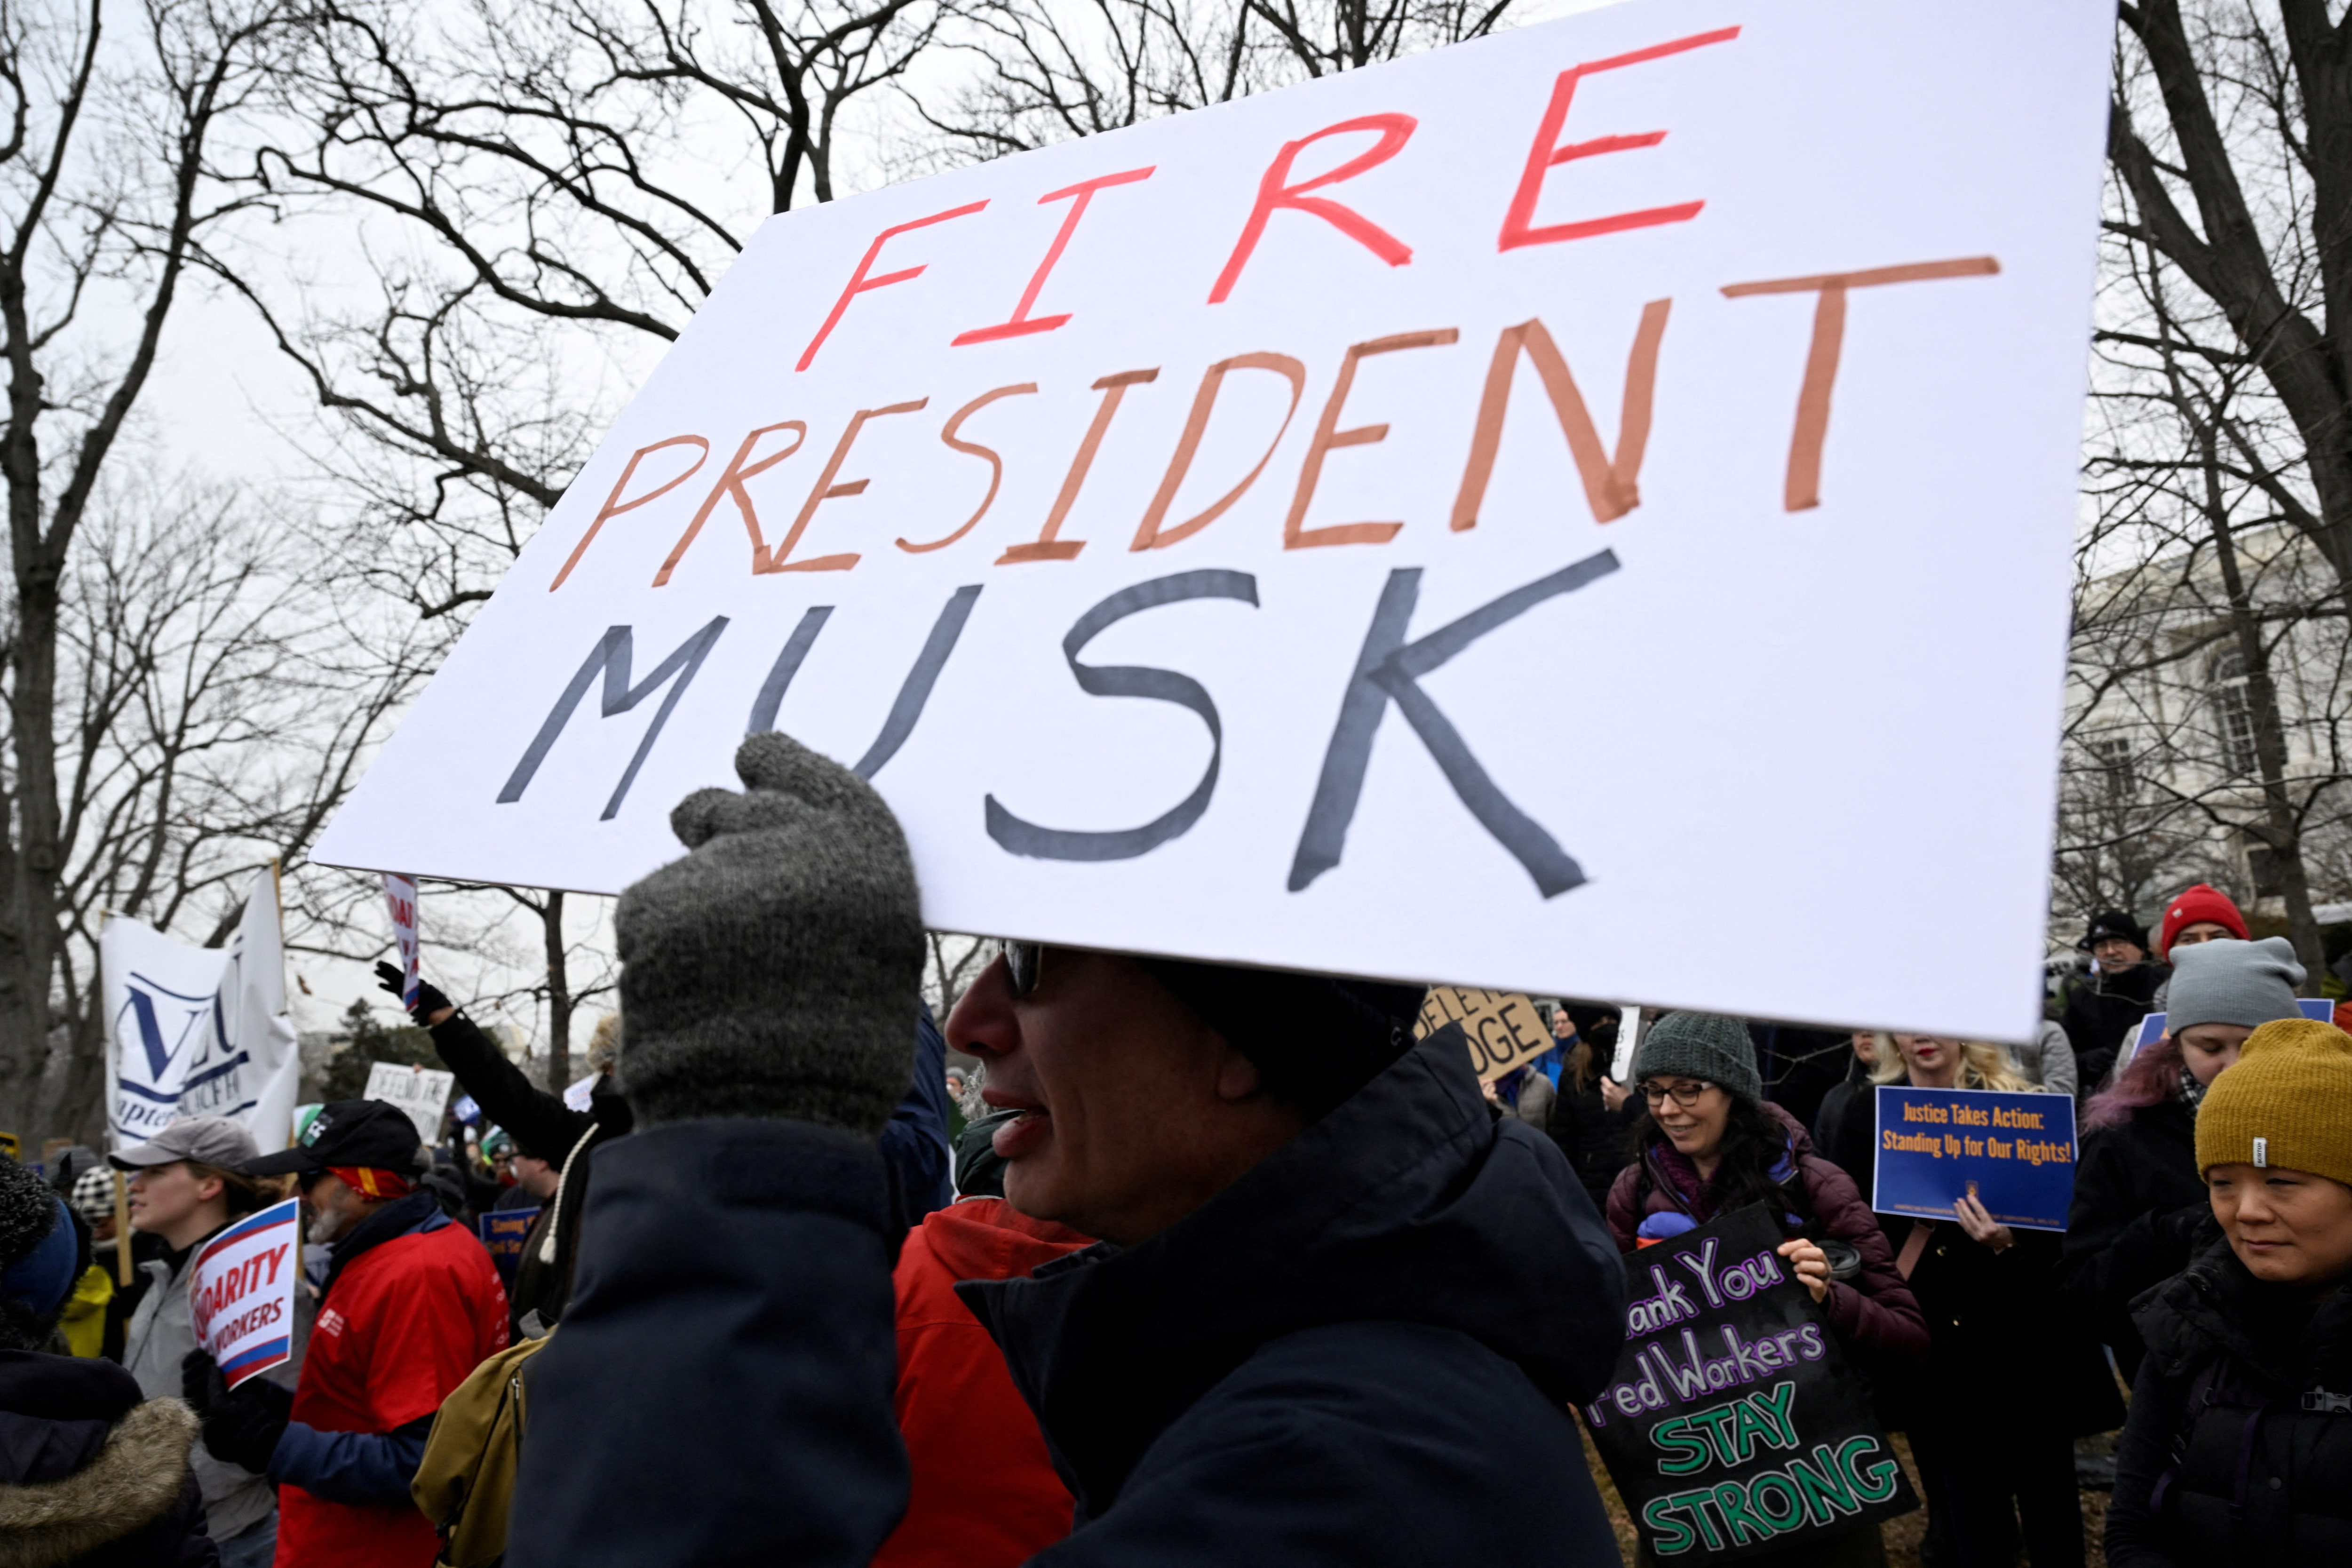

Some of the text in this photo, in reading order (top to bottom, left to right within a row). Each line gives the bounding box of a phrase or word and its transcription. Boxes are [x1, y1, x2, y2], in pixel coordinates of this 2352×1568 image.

[795, 24, 1742, 373] FIRE
[551, 257, 1999, 591] PRESIDENT
[495, 548, 1622, 900] MUSK
[1417, 987, 1513, 1043] DELE
[1464, 1002, 1542, 1076] OGE
[1883, 1130, 2072, 1166] Standing Up for Our Rights!
[1903, 1102, 2044, 1130] Justice Takes Action:
[1626, 1237, 1784, 1340] ank You
[1647, 1323, 1826, 1401] Workers
[1650, 1381, 1800, 1476] STAY
[1642, 1435, 1899, 1555] STRONG
